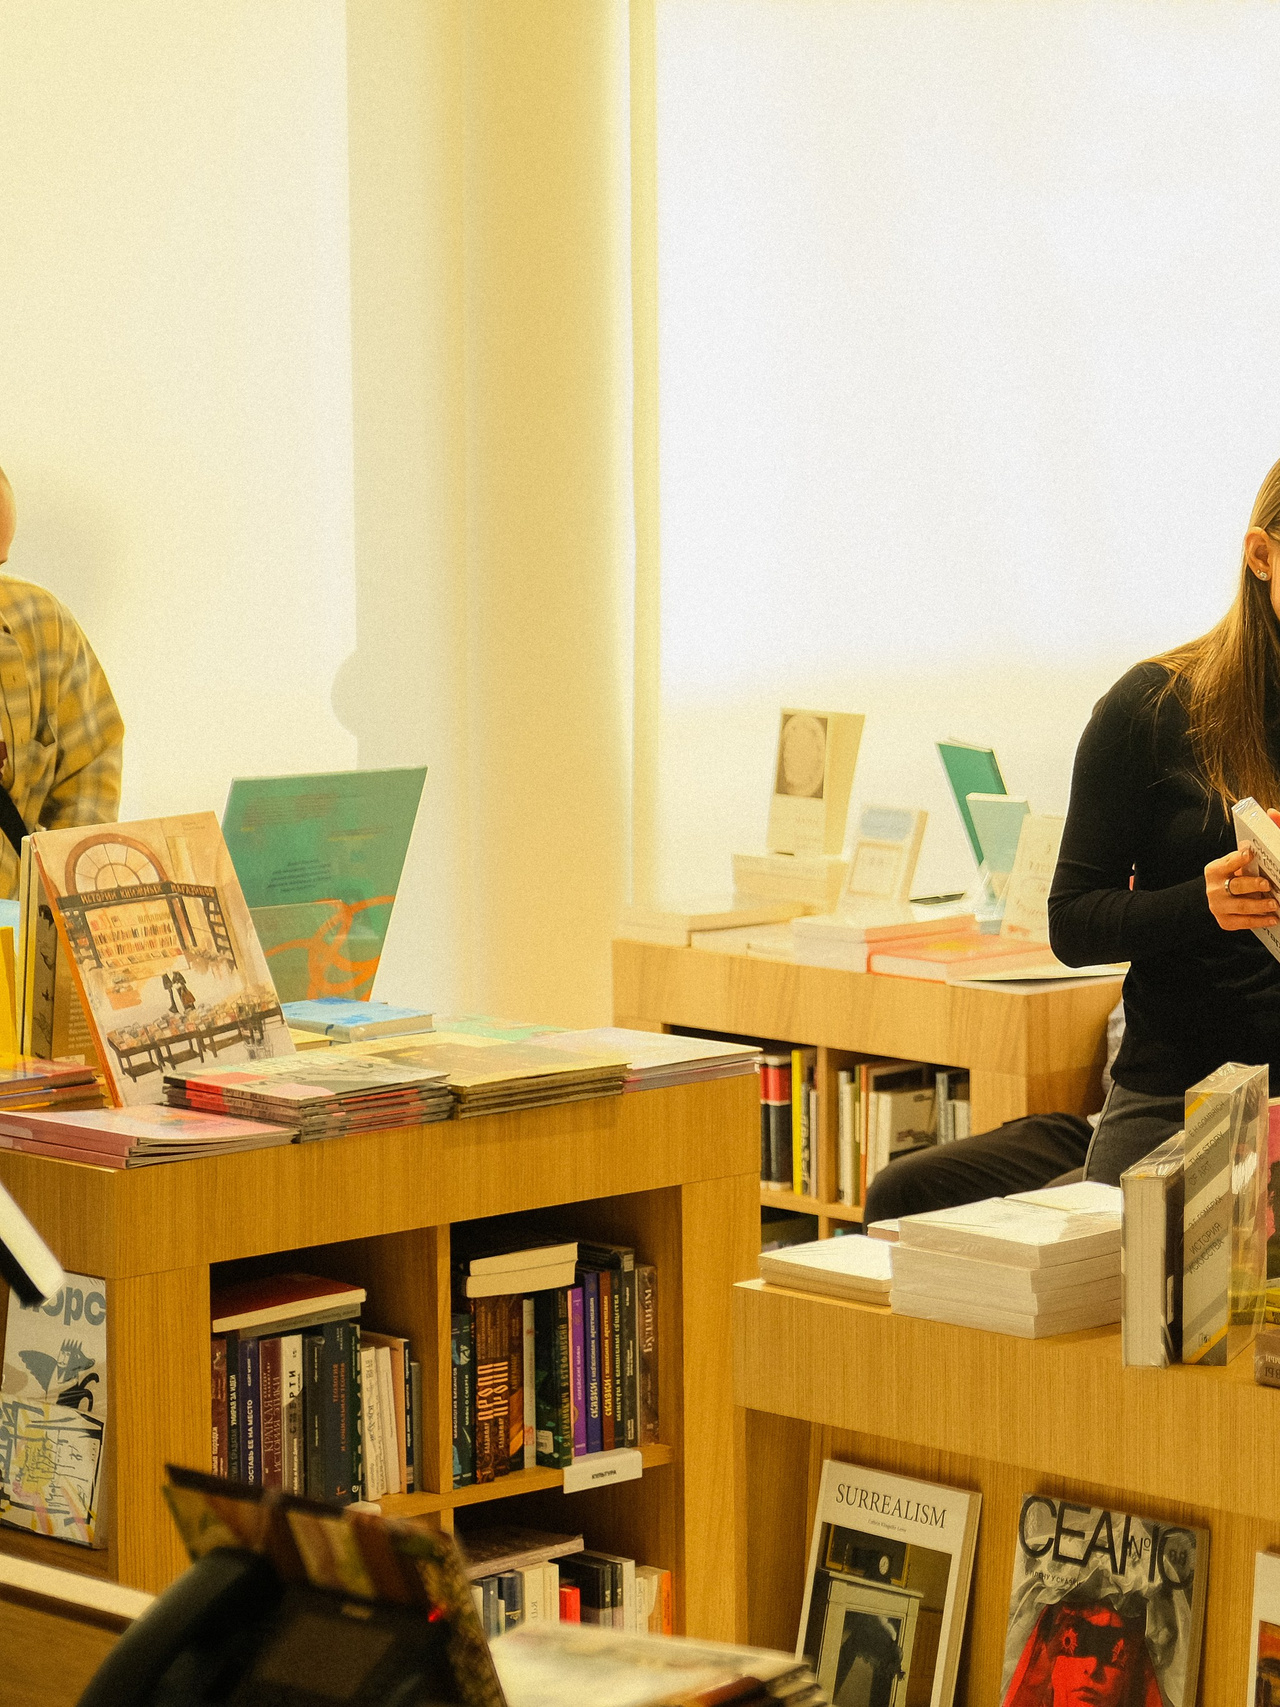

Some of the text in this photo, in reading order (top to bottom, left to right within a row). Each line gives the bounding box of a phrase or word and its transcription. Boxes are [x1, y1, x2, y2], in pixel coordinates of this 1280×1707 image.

[1202, 1131, 1224, 1154] STORY
[1188, 1222, 1223, 1255] ИСТОРИЯ
[288, 1370, 296, 1434] СМЕРТИ
[589, 1381, 599, 1419] СКАЗКИ
[603, 1378, 612, 1417] СКАЗКИ
[247, 1427, 254, 1439] НА
[263, 1400, 273, 1452] КРАТКАЯ
[272, 1376, 281, 1473] ИСТОРИЯ ЭТИКИ
[247, 1450, 255, 1486] ПОСТАВЬ
[835, 1483, 947, 1529] SURREALISM
